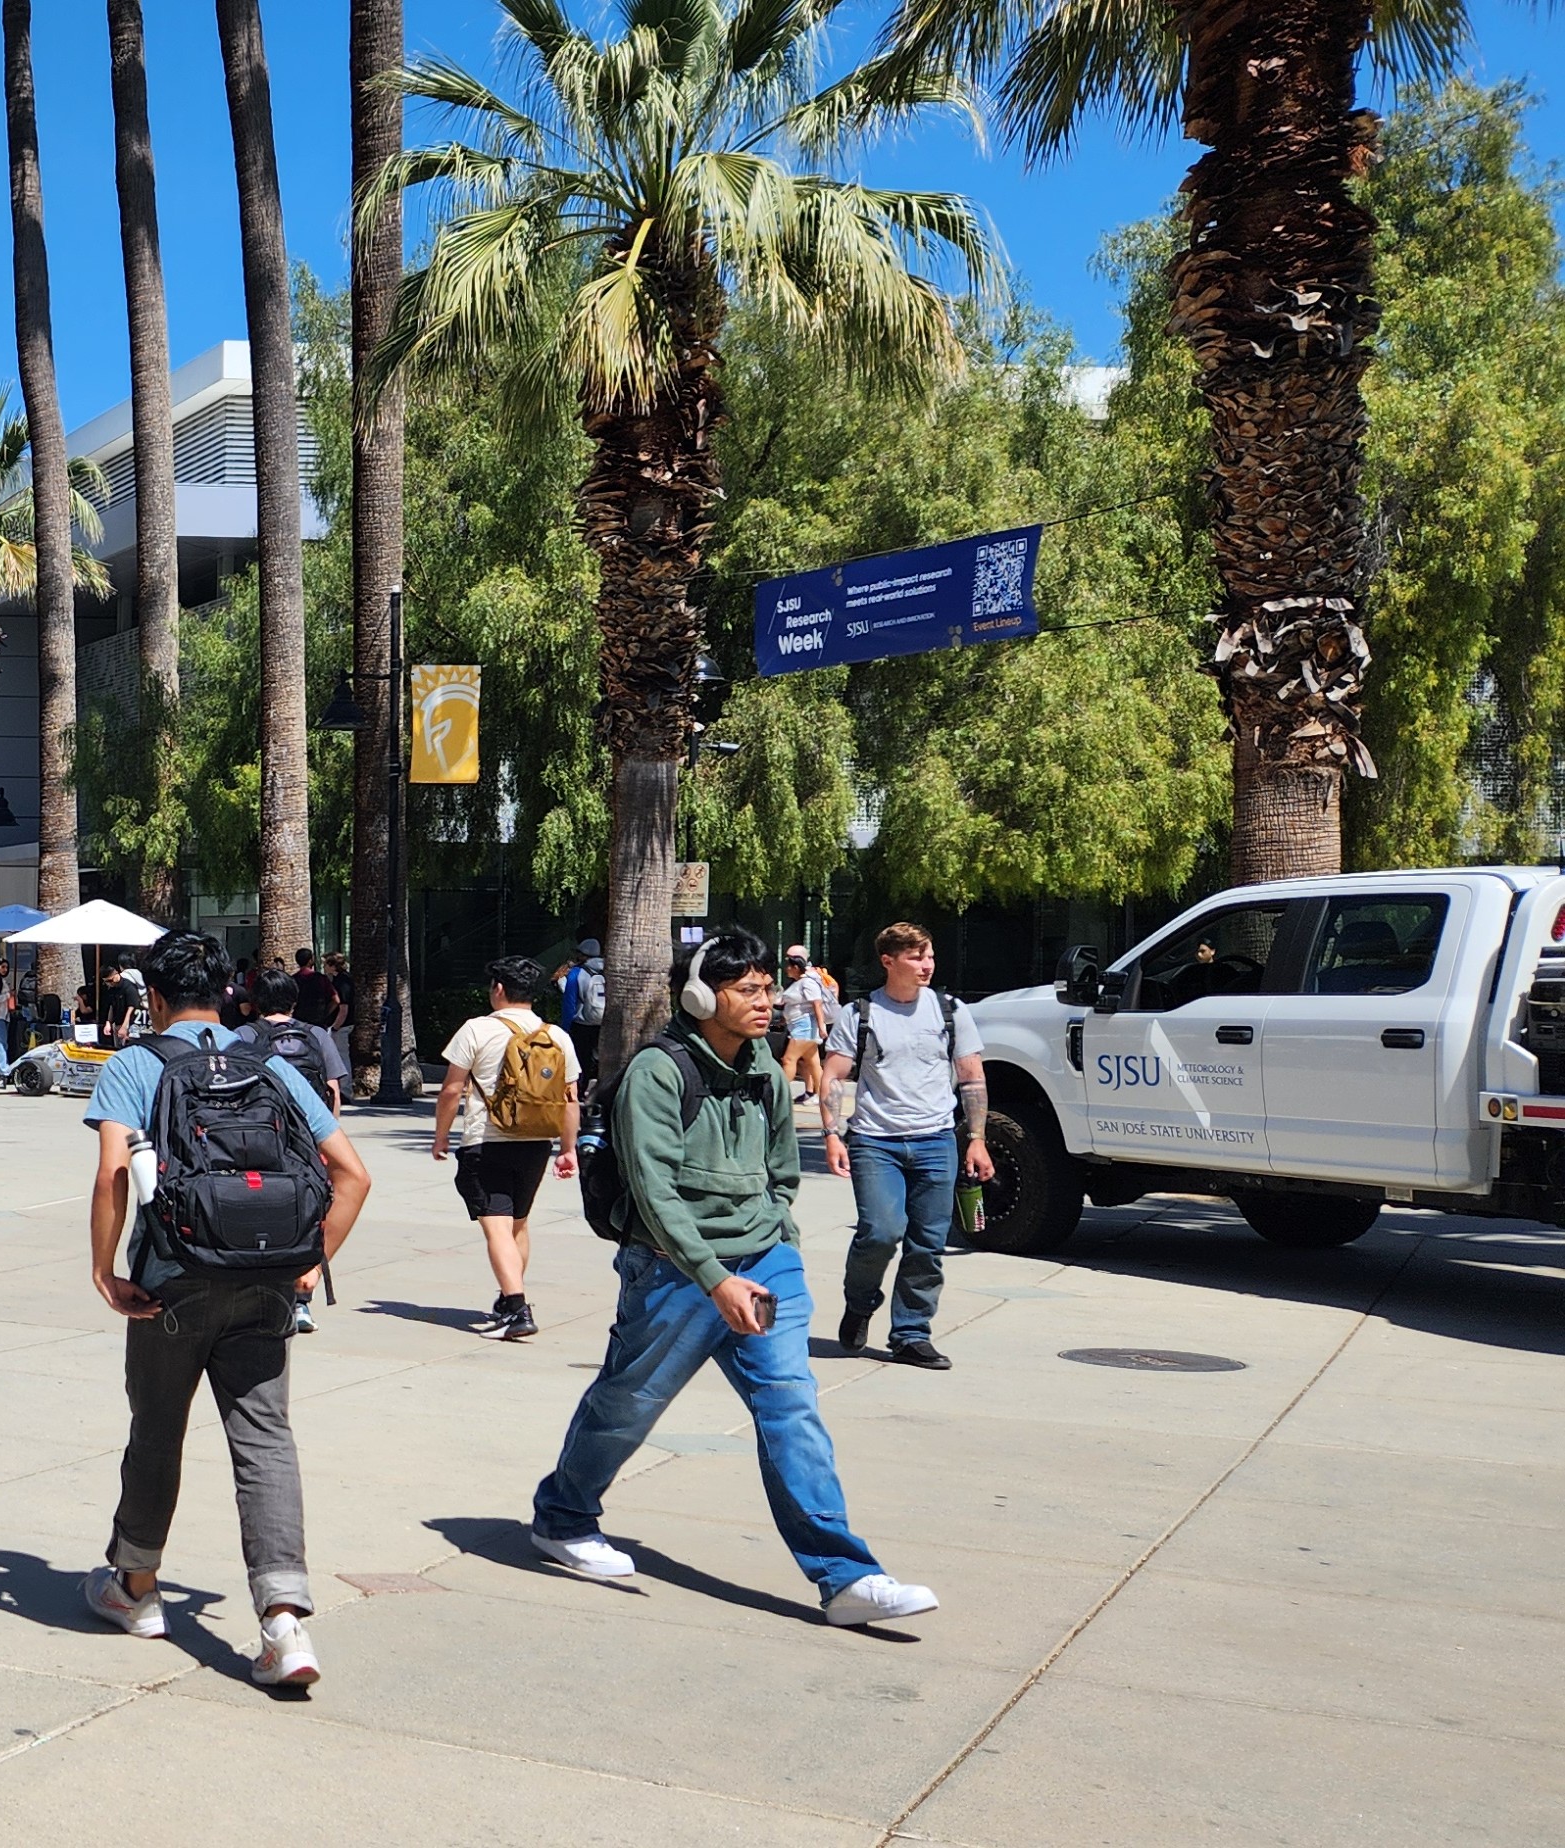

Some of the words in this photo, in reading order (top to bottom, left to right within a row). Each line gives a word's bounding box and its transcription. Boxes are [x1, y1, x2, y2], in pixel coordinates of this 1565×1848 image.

[847, 584, 870, 596] Where
[869, 574, 919, 593] public-impact
[919, 567, 953, 582] research
[776, 596, 802, 614] SJSU
[845, 597, 868, 609] meets
[868, 589, 904, 605] real-world
[904, 584, 937, 598] solutions
[785, 607, 833, 629] Research
[845, 620, 870, 639] SJSU
[778, 627, 824, 656] Week
[133, 1008, 147, 1025] 21
[1097, 1054, 1161, 1091] SJSU
[1177, 1063, 1235, 1074] METEOROLOGY
[1237, 1066, 1244, 1074] &
[1211, 1076, 1244, 1086] SCIENCE
[1096, 1120, 1119, 1133] SAN
[1122, 1120, 1147, 1136] JOSÉ
[1150, 1124, 1183, 1138] STATE
[1185, 1127, 1255, 1144] UNIVERSITY
